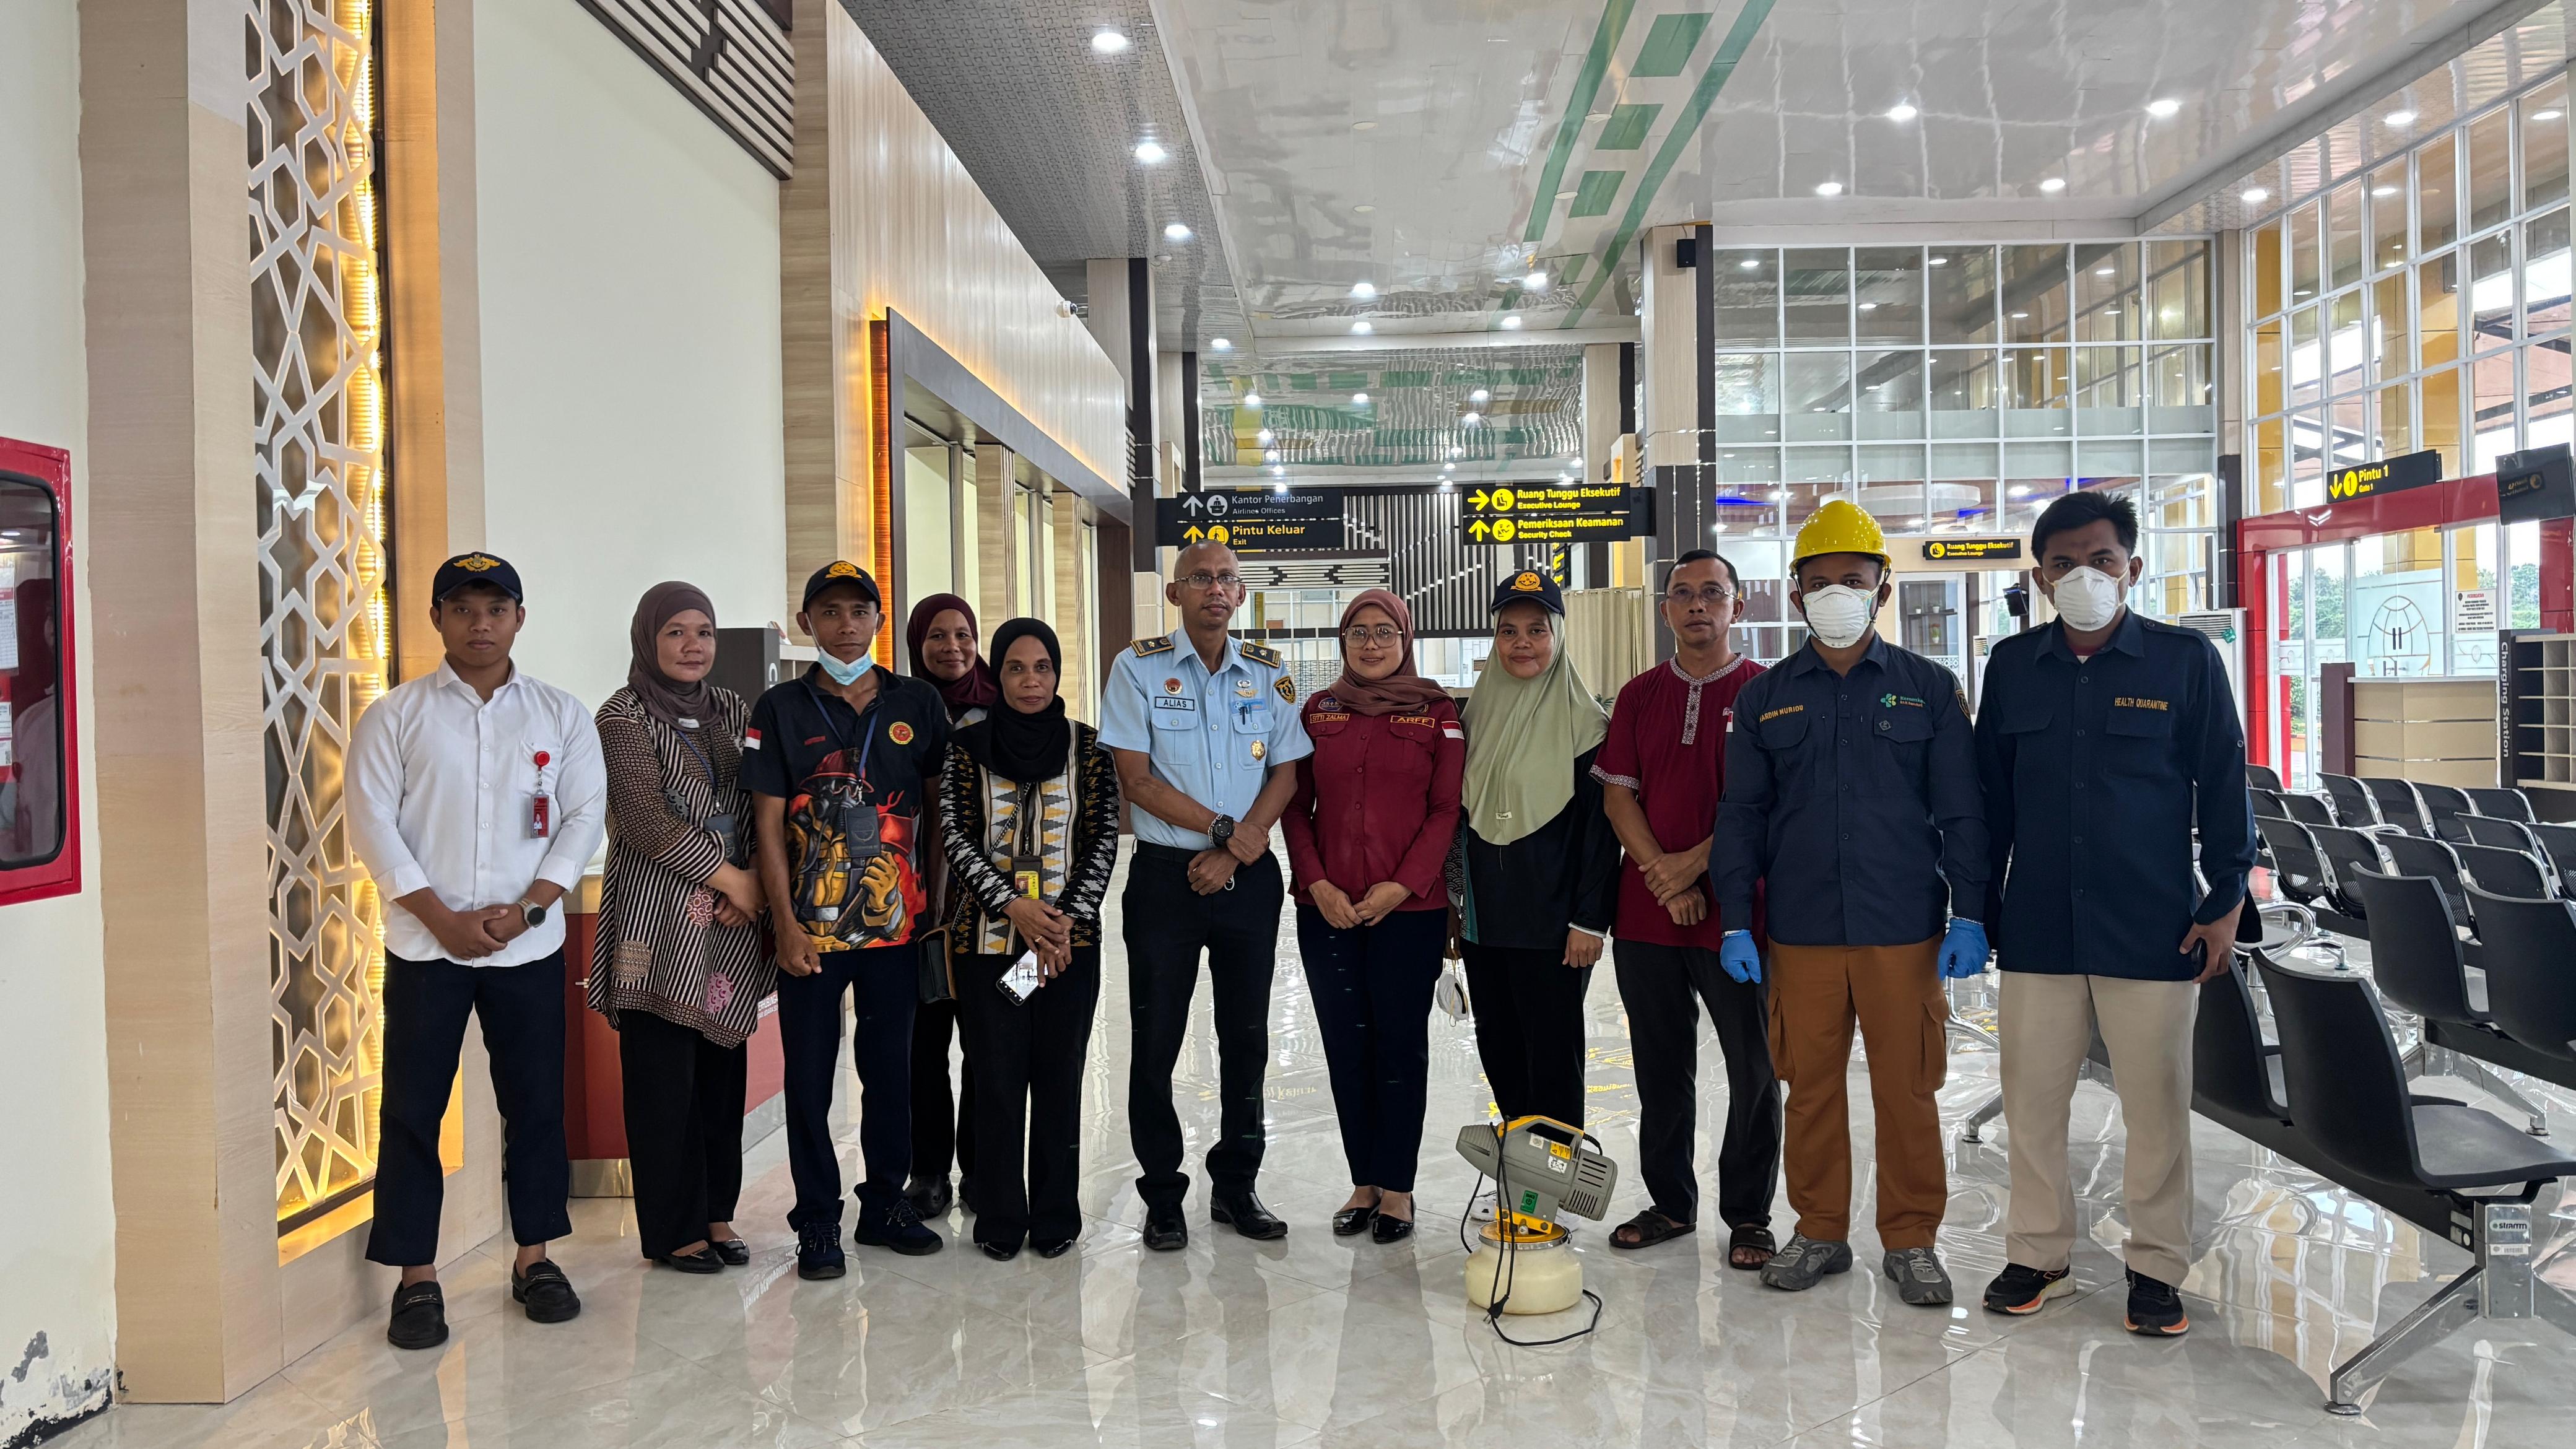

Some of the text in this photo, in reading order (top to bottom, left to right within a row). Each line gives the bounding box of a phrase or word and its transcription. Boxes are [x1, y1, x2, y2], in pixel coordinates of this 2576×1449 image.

[2359, 464, 2388, 482] Pintu 1
[1517, 487, 1621, 500] Ruang Tunggu Eksekutif
[1232, 494, 1323, 505] Kantor Penerbangan
[1517, 502, 1552, 510] Executive
[1518, 518, 1624, 529] Pemeriksaan Keamanan
[1232, 525, 1305, 536] Pintu Keluar
[1518, 531, 1548, 539] Security
[1164, 699, 1187, 708] ALIAS
[2115, 697, 2169, 711] HEALTH QUARANTINE
[2501, 642, 2510, 758] Charging Station
